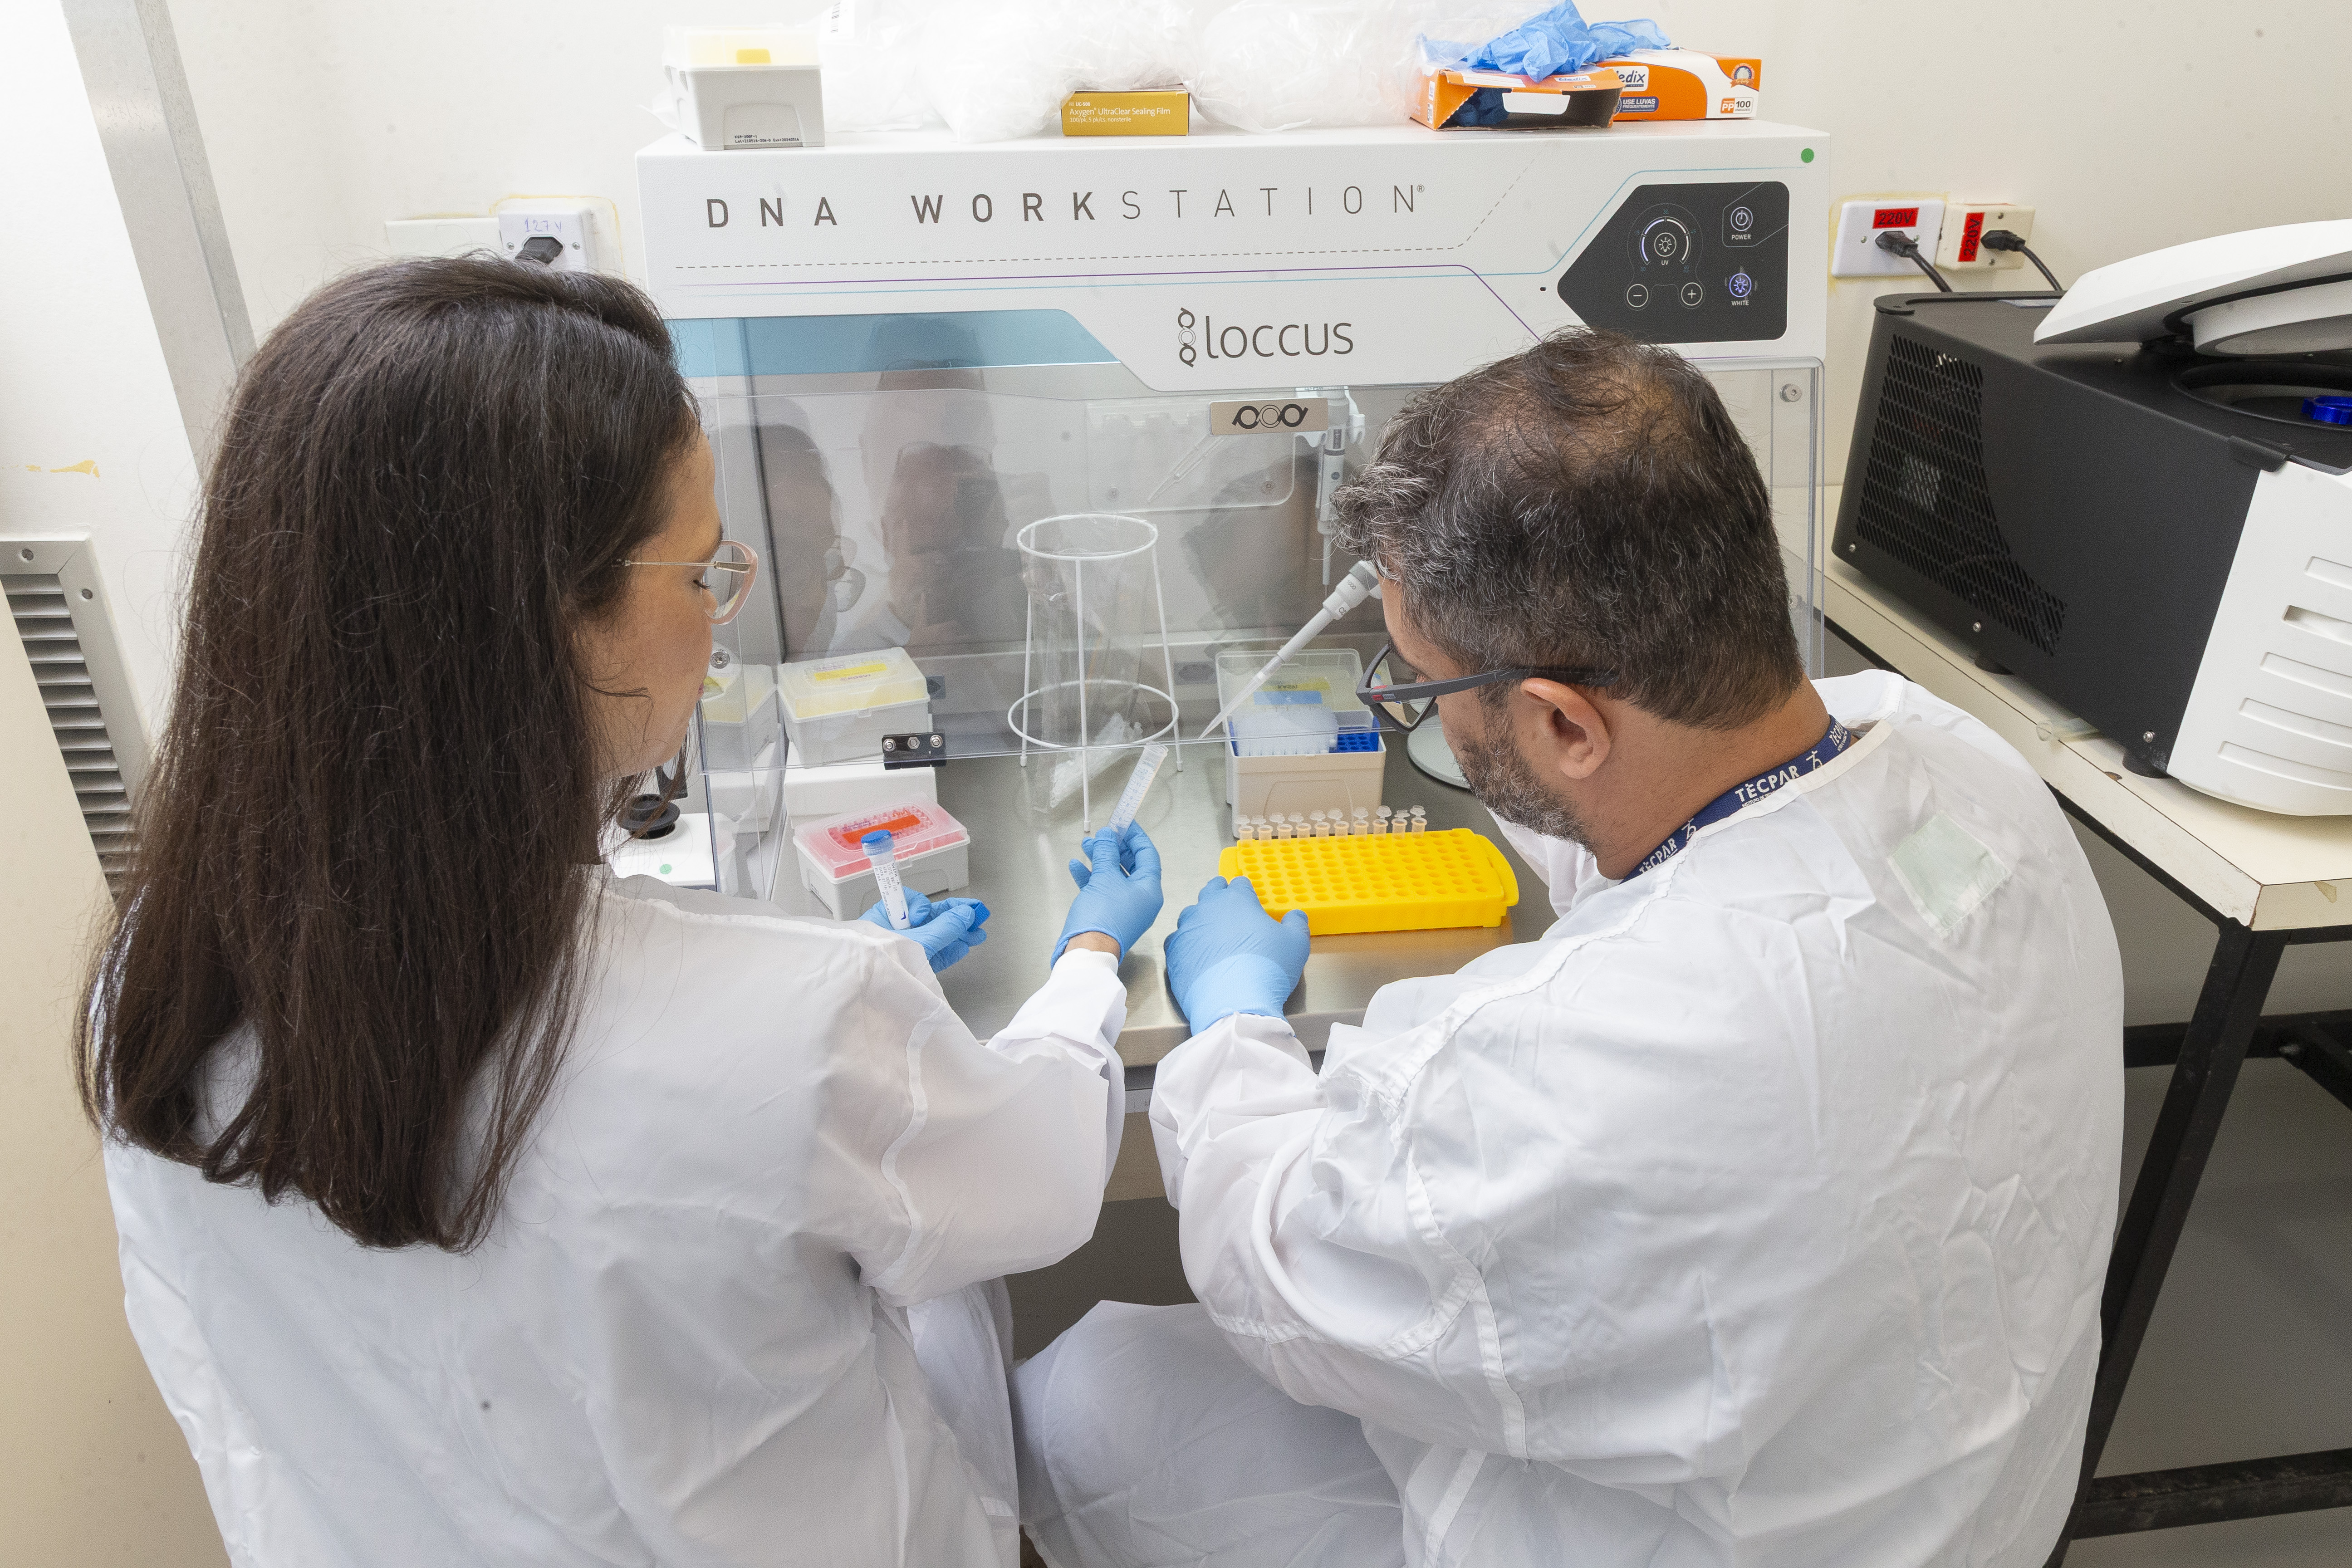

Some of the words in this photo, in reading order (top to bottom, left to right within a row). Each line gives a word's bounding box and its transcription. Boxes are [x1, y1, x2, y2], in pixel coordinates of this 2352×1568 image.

[1616, 70, 1646, 83] edix
[1132, 108, 1156, 117] Sealing
[1722, 103, 1734, 111] PP
[706, 197, 838, 228] DNA
[1878, 211, 1913, 225] 220V
[1964, 218, 1981, 256] 220V
[1205, 316, 1354, 359] loccus
[882, 892, 892, 916] FORMULADO
